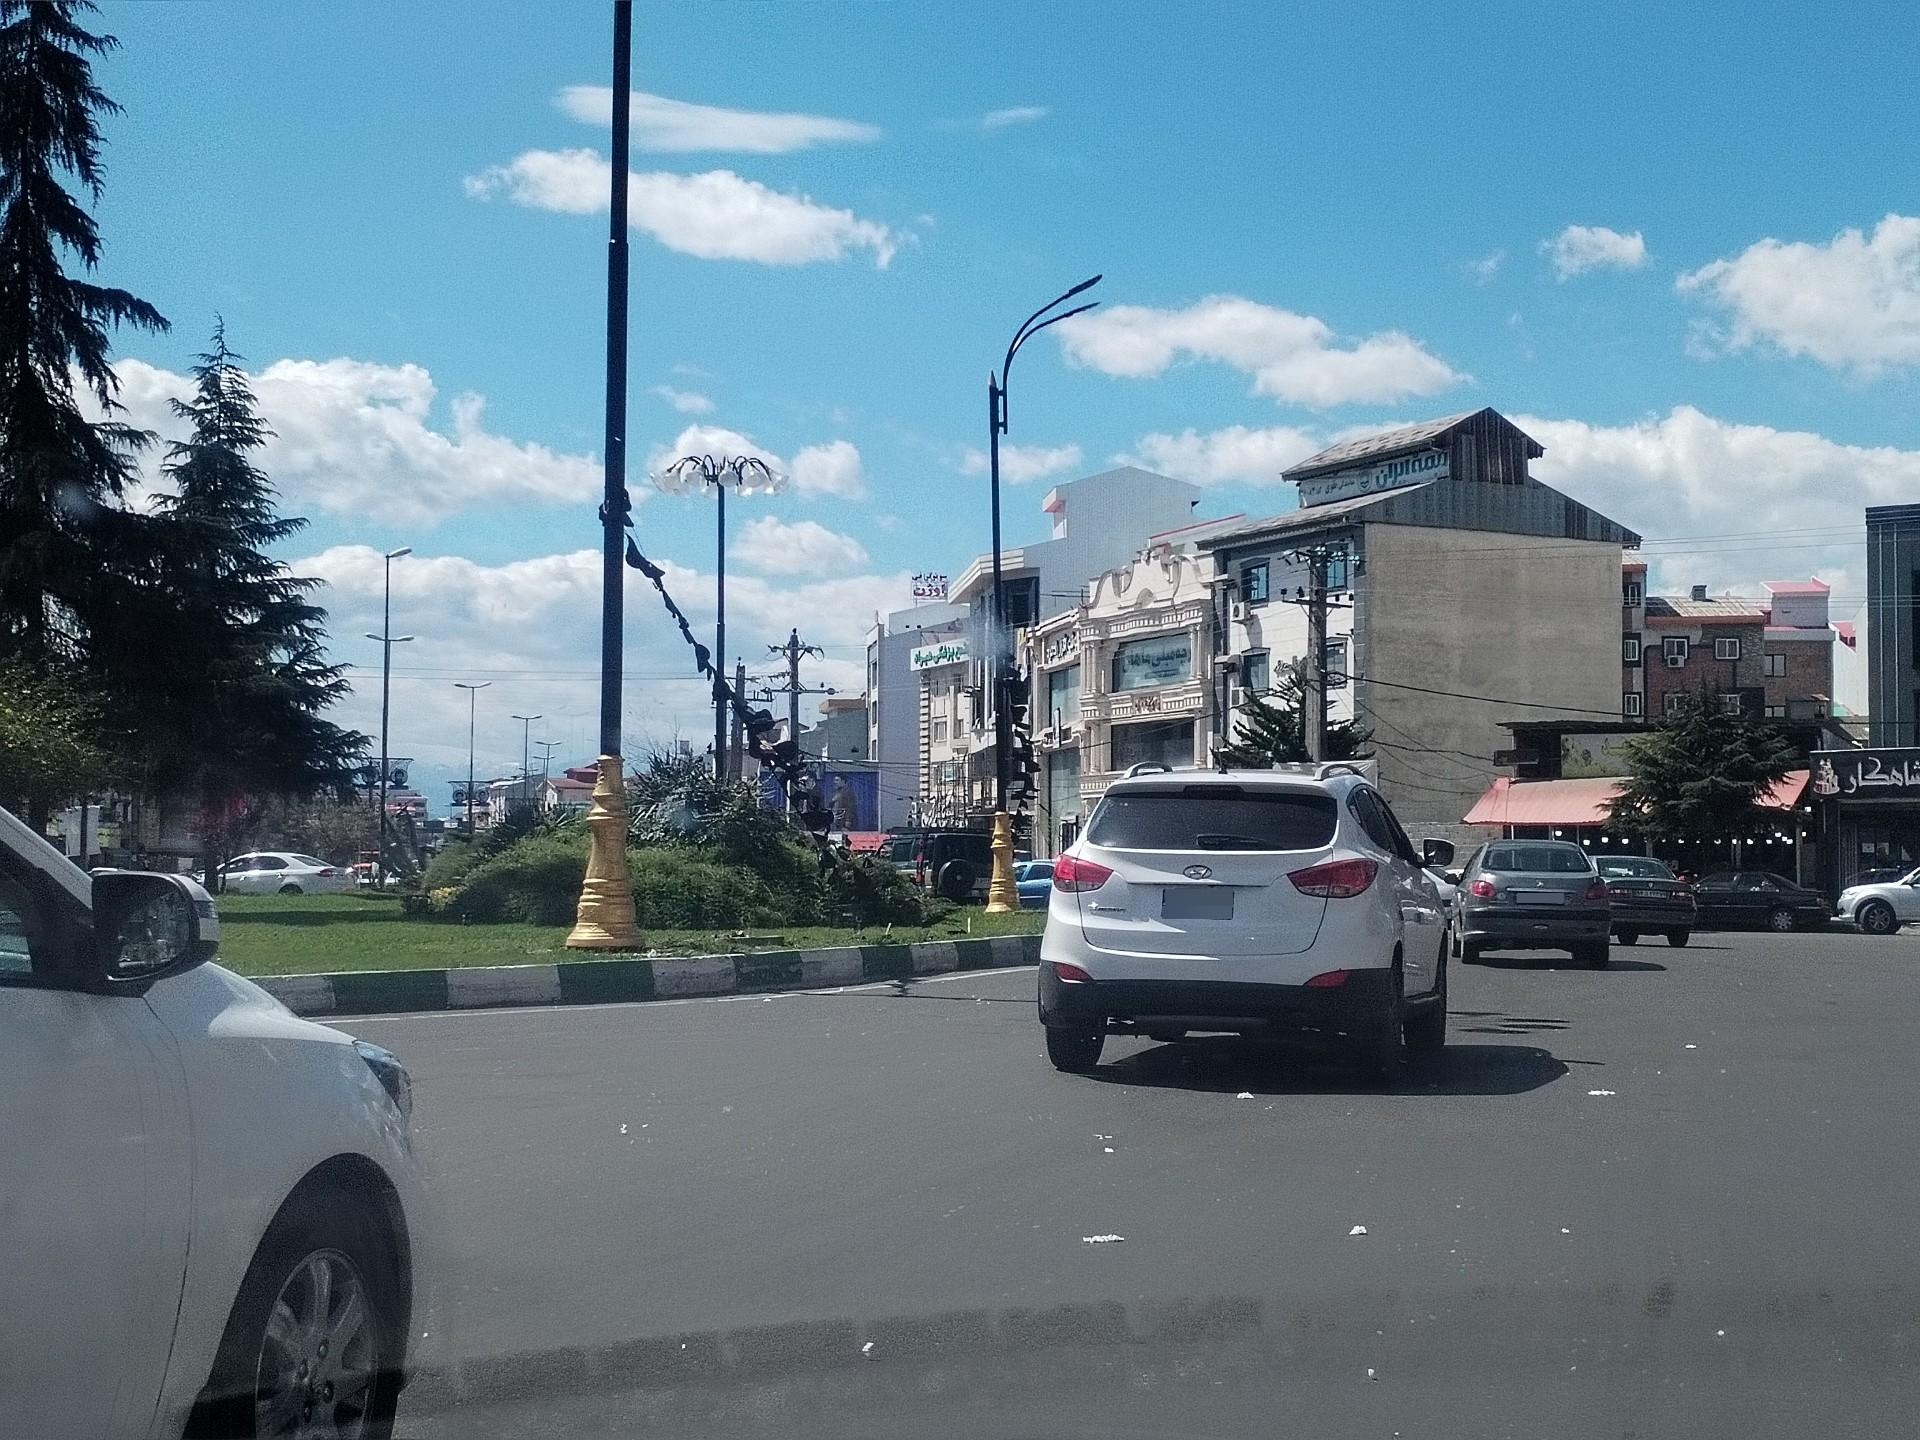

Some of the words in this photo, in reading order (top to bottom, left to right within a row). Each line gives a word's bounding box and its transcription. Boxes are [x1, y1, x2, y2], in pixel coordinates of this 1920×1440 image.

[1375, 460, 1410, 489] ایران
[1411, 450, 1449, 477] بیمه
[1843, 756, 1920, 794] شاهکار
